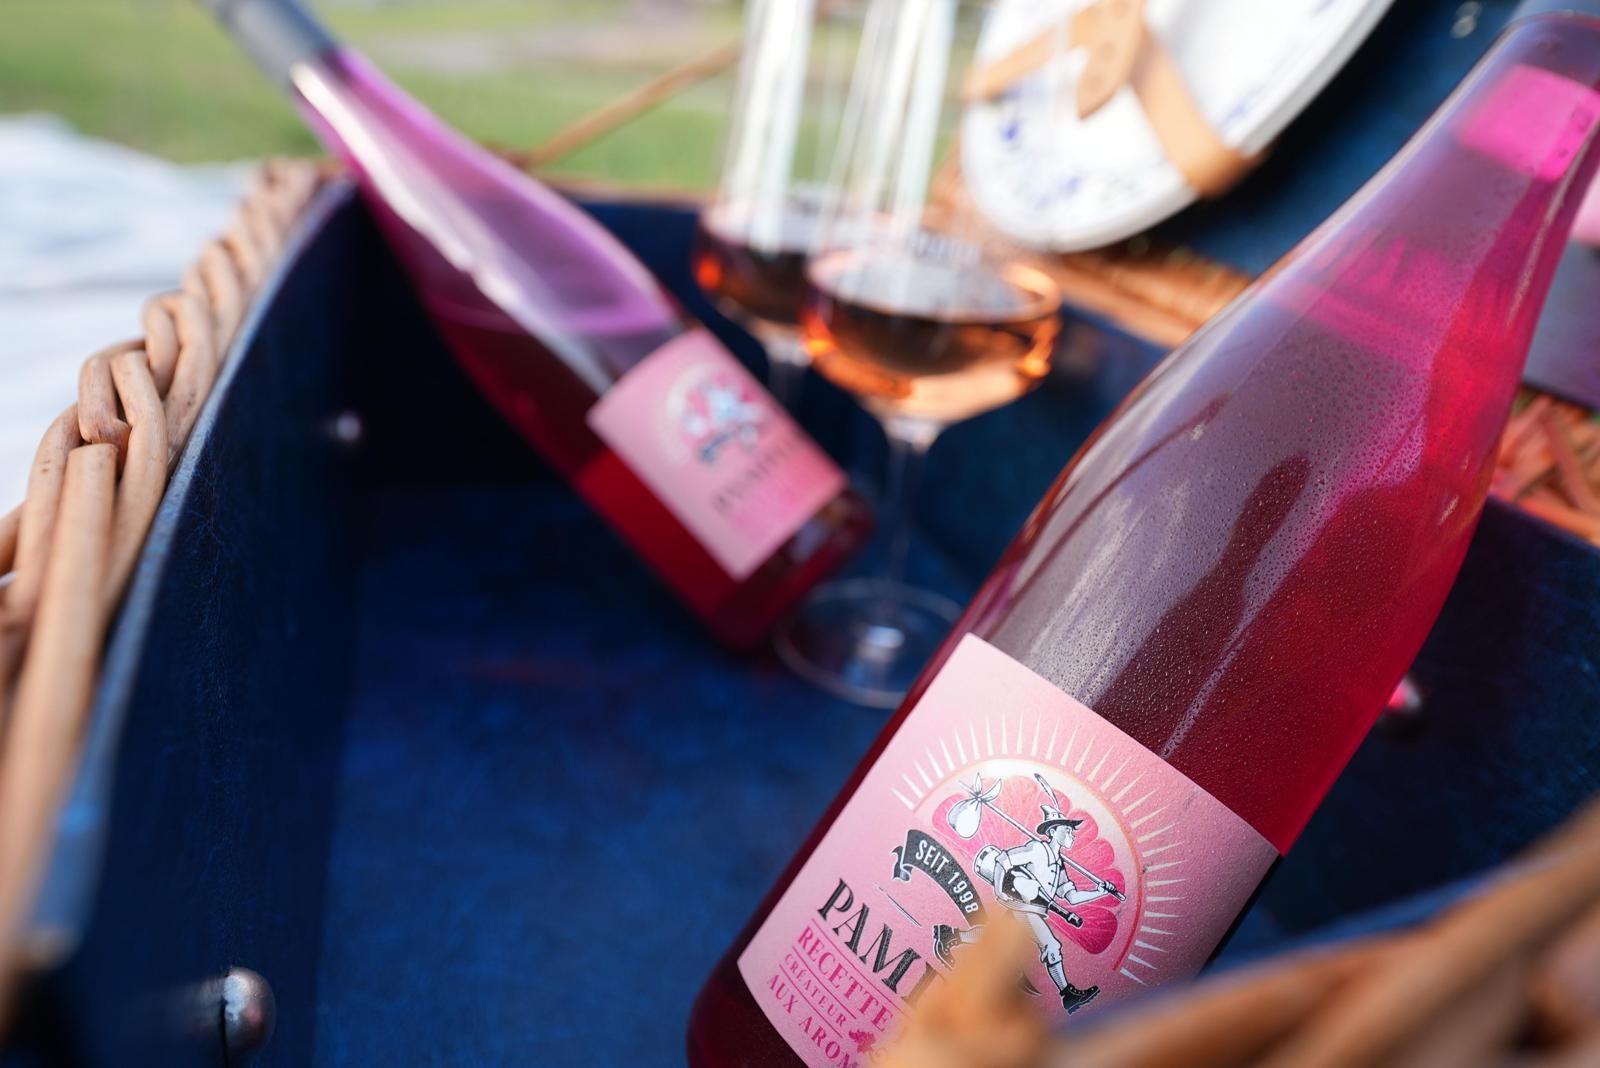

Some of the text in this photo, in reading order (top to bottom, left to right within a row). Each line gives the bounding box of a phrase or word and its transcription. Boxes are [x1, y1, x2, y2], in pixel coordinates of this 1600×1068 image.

[915, 839, 979, 913] SEIT 1998
[767, 974, 799, 1014] AUX
[784, 953, 847, 1028] CRÉATEUR
[798, 926, 893, 1032] RECETTE
